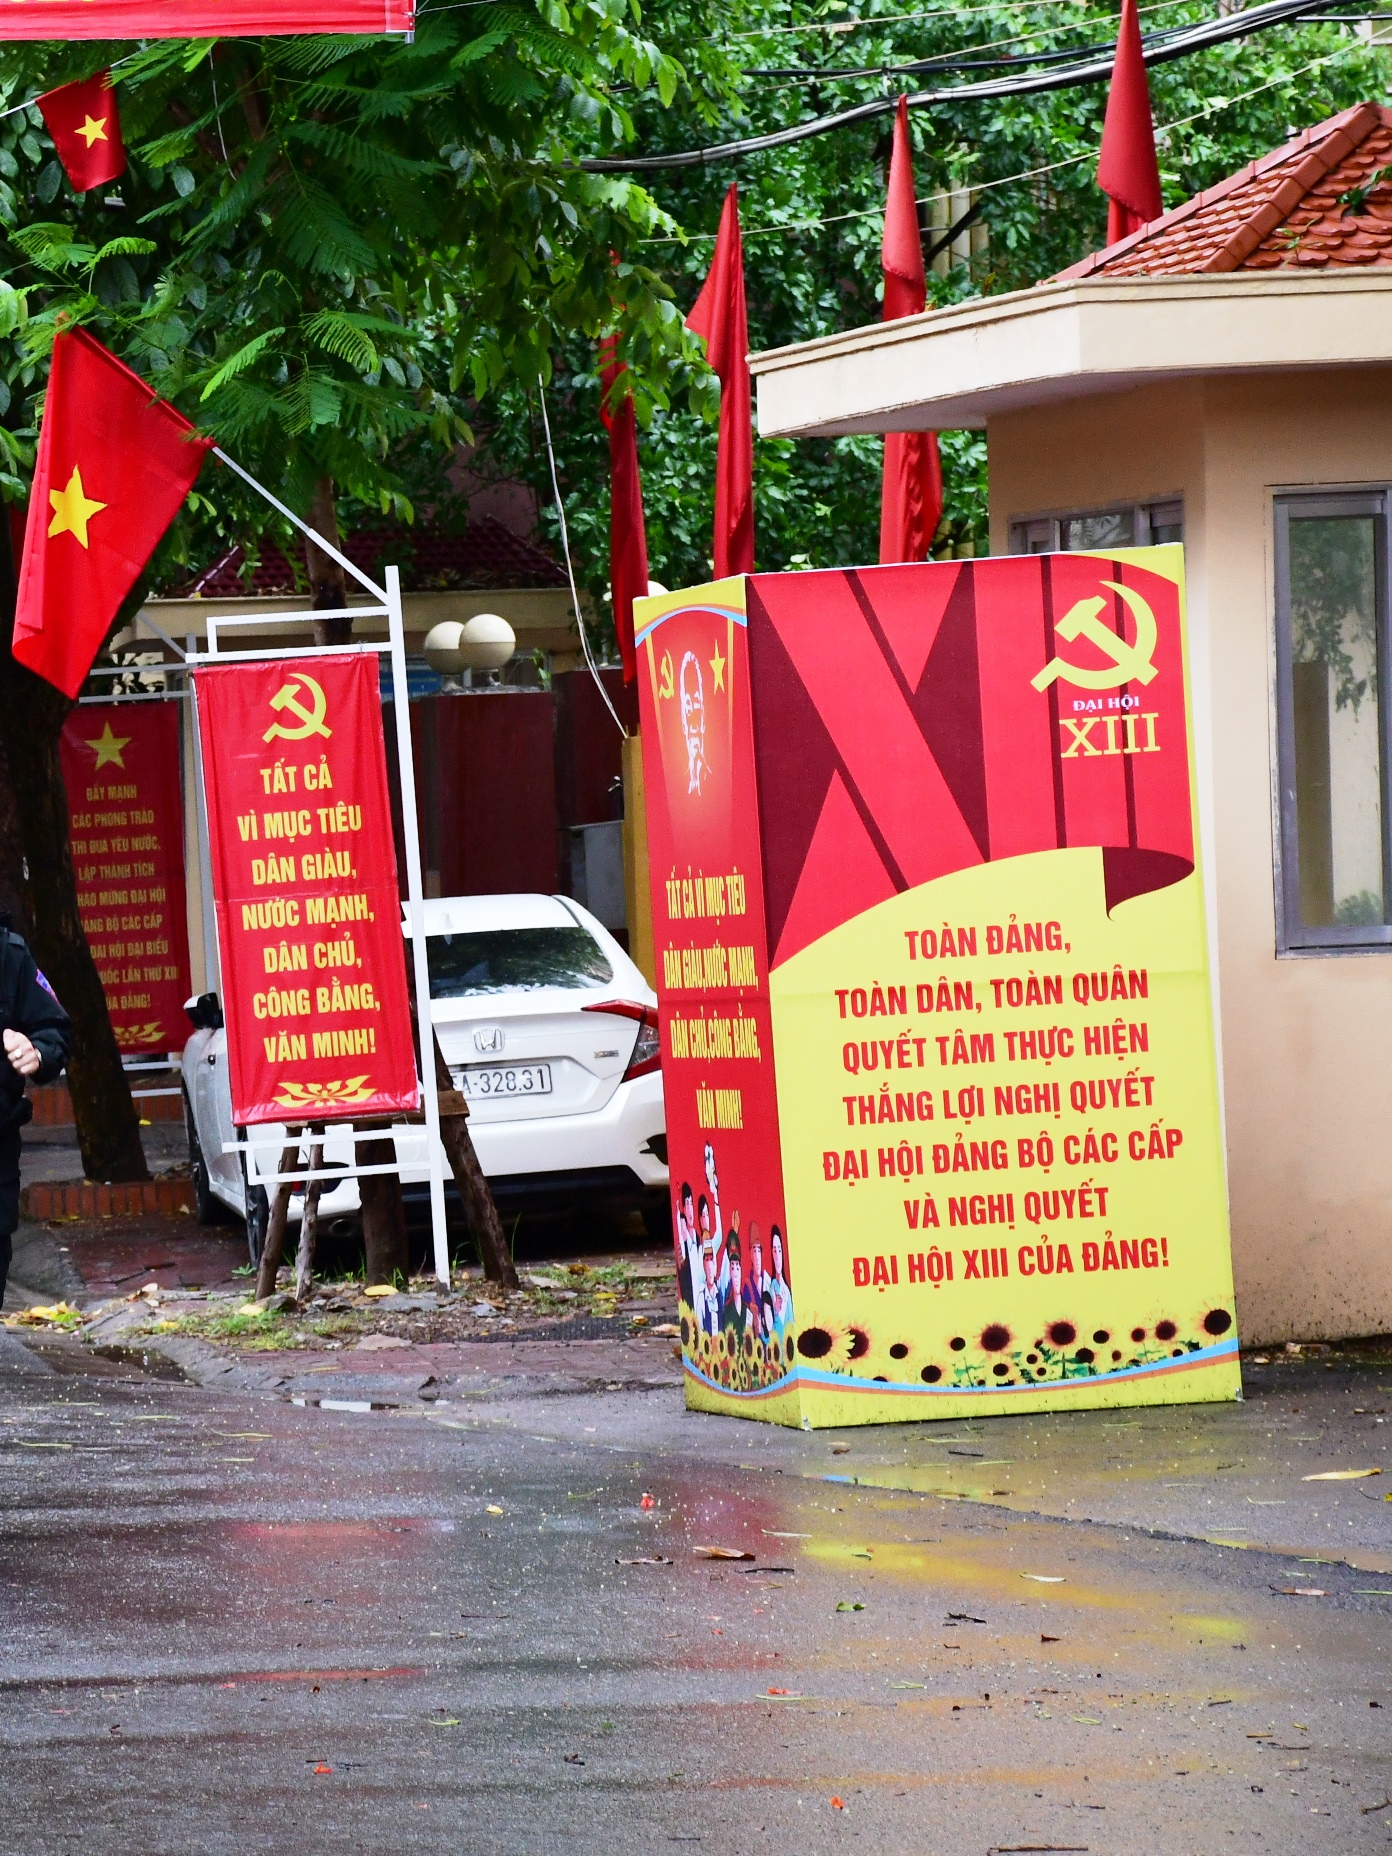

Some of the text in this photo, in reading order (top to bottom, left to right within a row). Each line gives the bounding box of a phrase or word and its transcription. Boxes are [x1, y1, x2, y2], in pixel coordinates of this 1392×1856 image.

[1073, 694, 1140, 713] ĐẠI HỘI
[1059, 712, 1161, 758] XIII
[260, 754, 333, 794] TẤT CẢ
[94, 811, 128, 827] PHONG
[237, 801, 362, 843] VÌ MỤC TIÊU
[71, 840, 87, 855] THI
[110, 835, 129, 852] YÊU
[251, 847, 357, 885] DÂN GIÀU,
[133, 861, 155, 877] TÍCH
[77, 890, 97, 907] HÀO
[149, 885, 166, 905] HỘI
[242, 894, 375, 931] NƯỚC MẠNH,
[666, 865, 746, 925] TẤT CẢ VÌ MỤC TIÊU
[82, 915, 104, 933] ẢNG
[121, 913, 141, 931] CÁC
[143, 909, 163, 929] CẤP
[904, 914, 1071, 960] TOÀN ĐẢNG,
[263, 931, 362, 973] DÂN CHỦ,
[663, 941, 682, 989] DÂN
[728, 946, 759, 996] MẠNH,
[99, 965, 120, 985] UỐC
[835, 964, 1149, 1019] TOÀN DÂN, TOÀN QUÂN
[106, 993, 118, 1010] ỦA
[253, 976, 381, 1019] CÔNG BẰNG,
[263, 1027, 376, 1063] VĂN MINH!
[670, 1011, 689, 1058] DÂN
[733, 1003, 761, 1063] BẰNG,
[842, 1018, 1149, 1075] QUYẾT TÂM THỰC HIỆN
[696, 1081, 744, 1129] VĂN MINH!
[842, 1067, 1155, 1126] THẮNG LỢI NGHỊ QUYẾT
[822, 1118, 1184, 1186] ĐẠI HỘI ĐẢNG BỘ CÁC CẤP
[903, 1178, 1109, 1230] VÀ NGHỊ QUYẾT
[852, 1230, 1170, 1292] ĐẠI HỘI XIII CỦA ĐẢNG!
